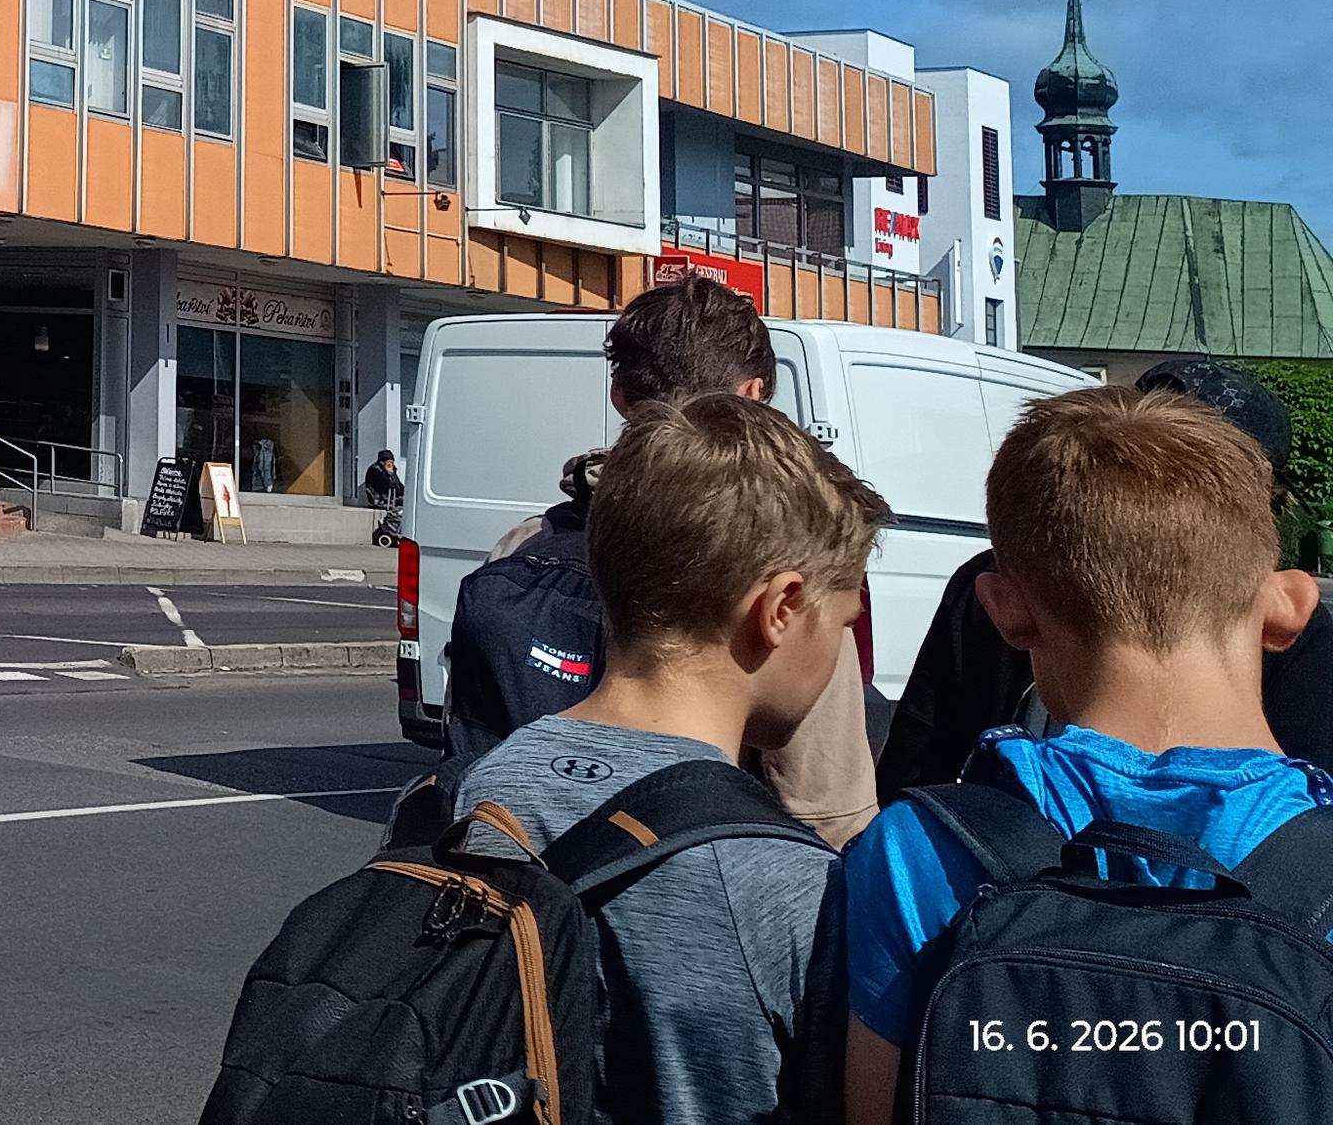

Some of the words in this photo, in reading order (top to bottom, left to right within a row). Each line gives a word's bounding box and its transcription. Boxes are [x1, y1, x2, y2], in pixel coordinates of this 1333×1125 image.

[262, 299, 318, 329] Pekařství
[541, 643, 583, 662] TOMMY
[534, 660, 580, 683] JEANS
